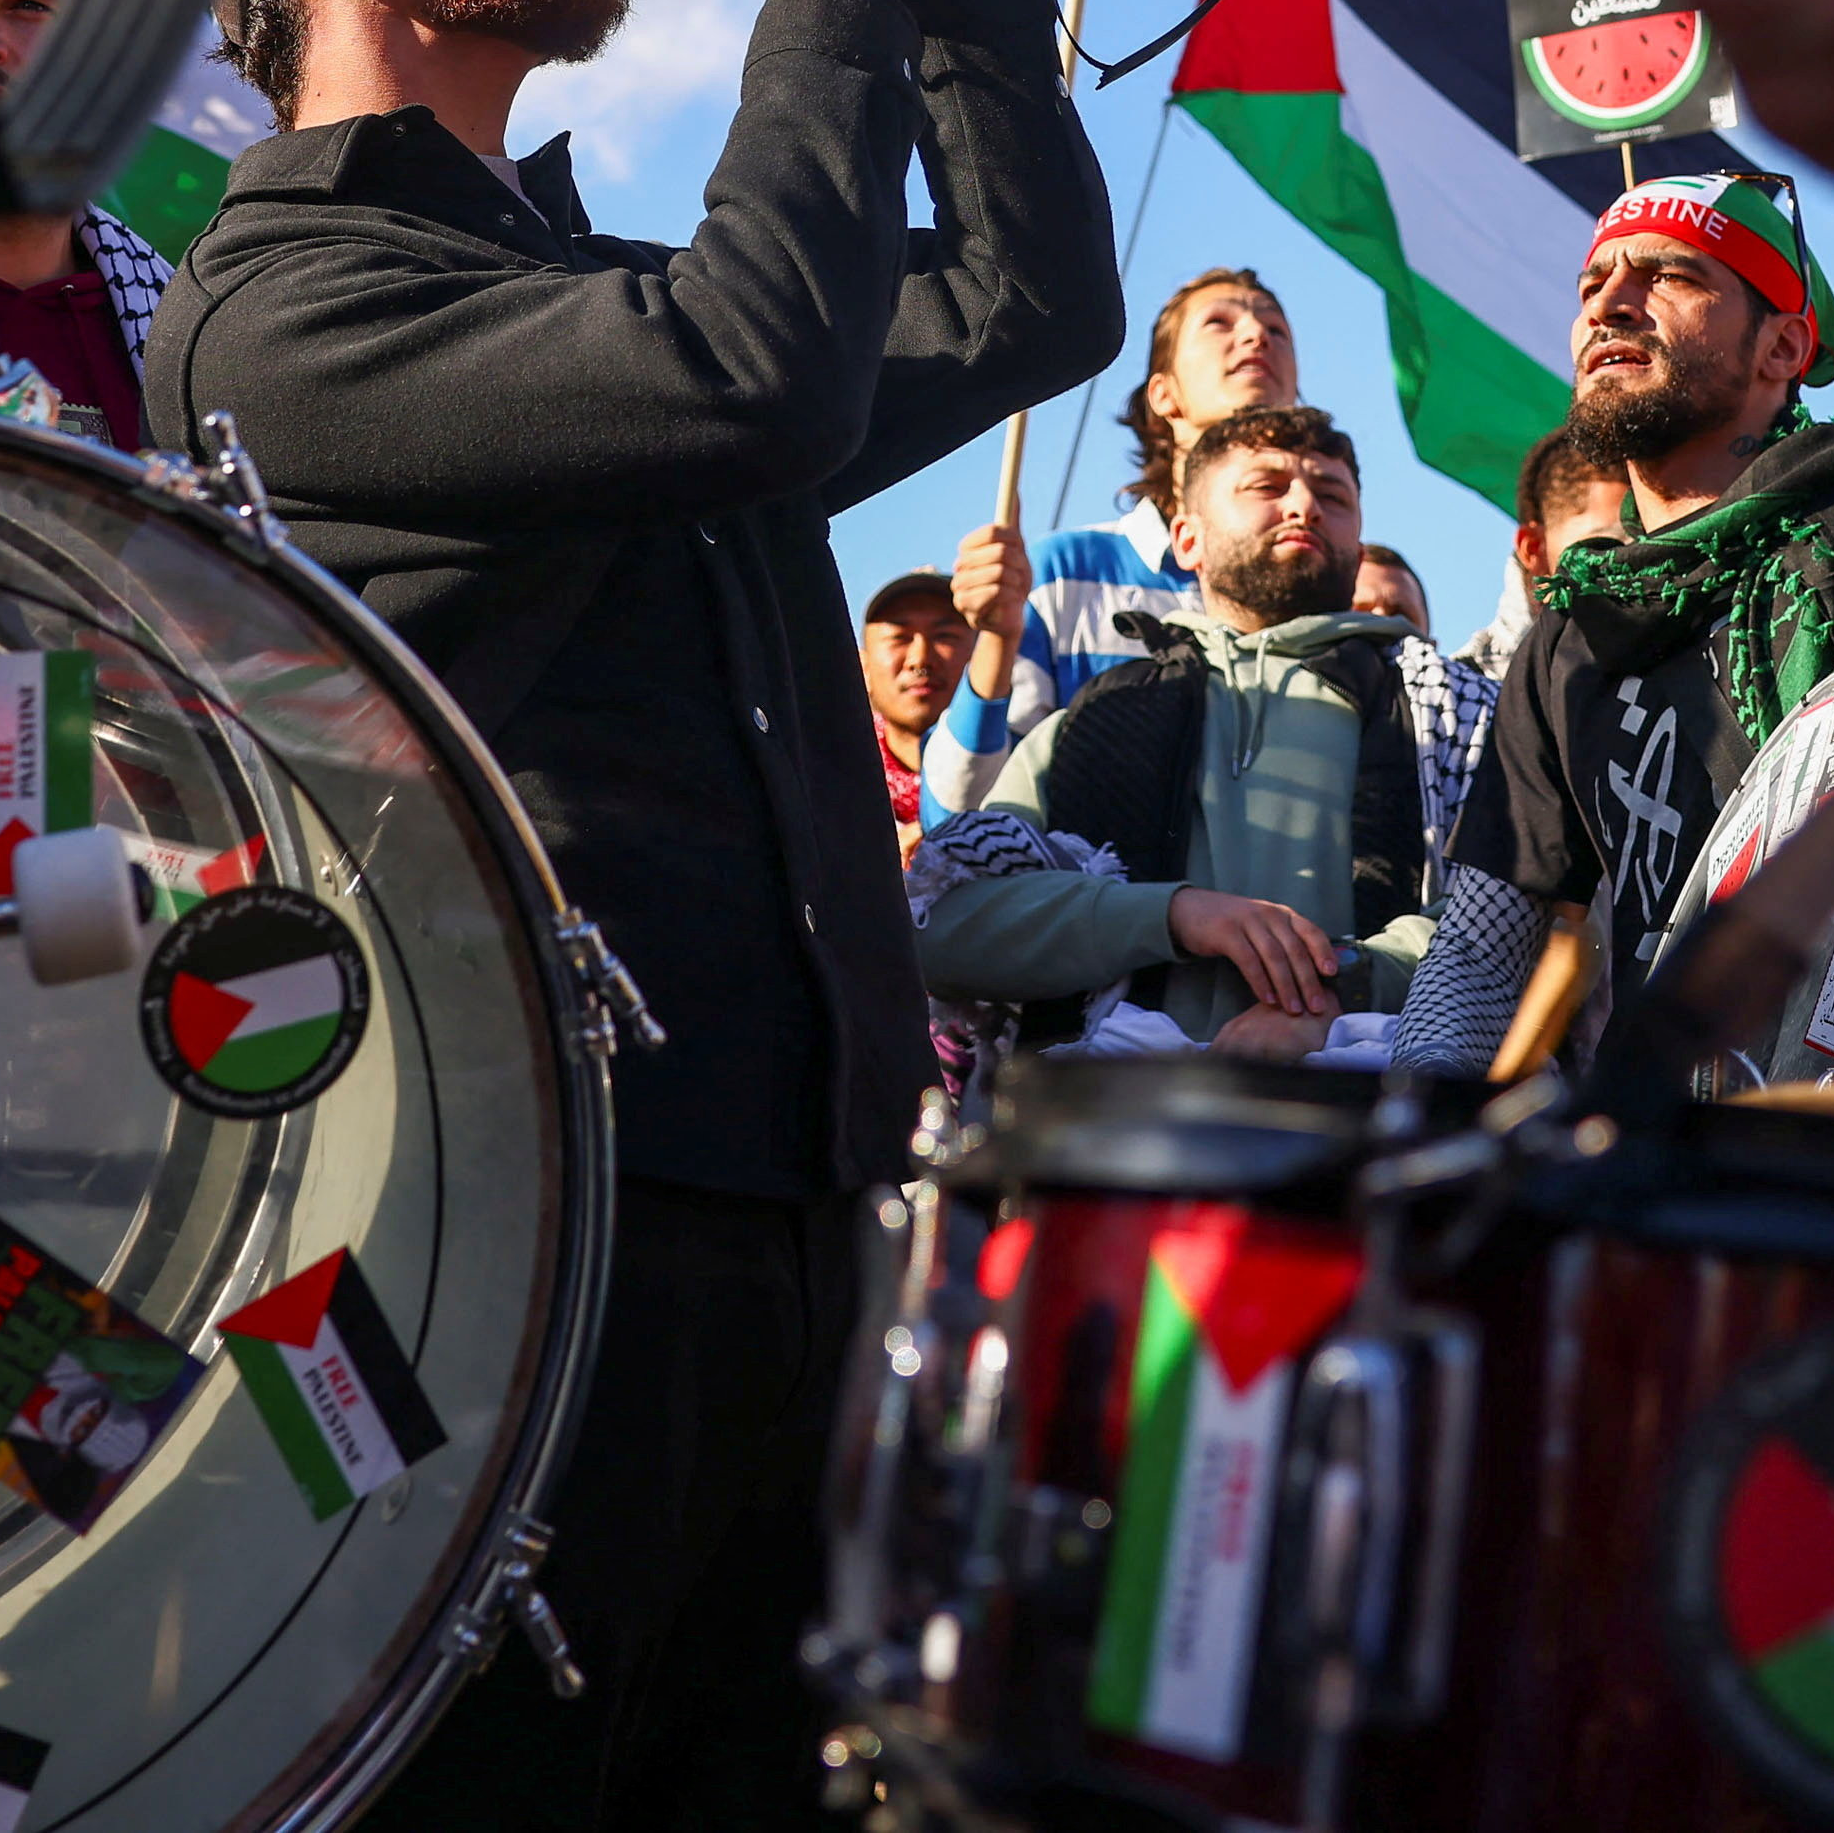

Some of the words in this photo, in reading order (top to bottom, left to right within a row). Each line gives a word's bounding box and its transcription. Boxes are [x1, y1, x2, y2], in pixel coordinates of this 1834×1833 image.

[1594, 197, 1728, 241] LESTINE
[19, 684, 37, 800] PALESTINE
[302, 1367, 363, 1467] PALESTINE
[320, 1354, 362, 1410] FREE
